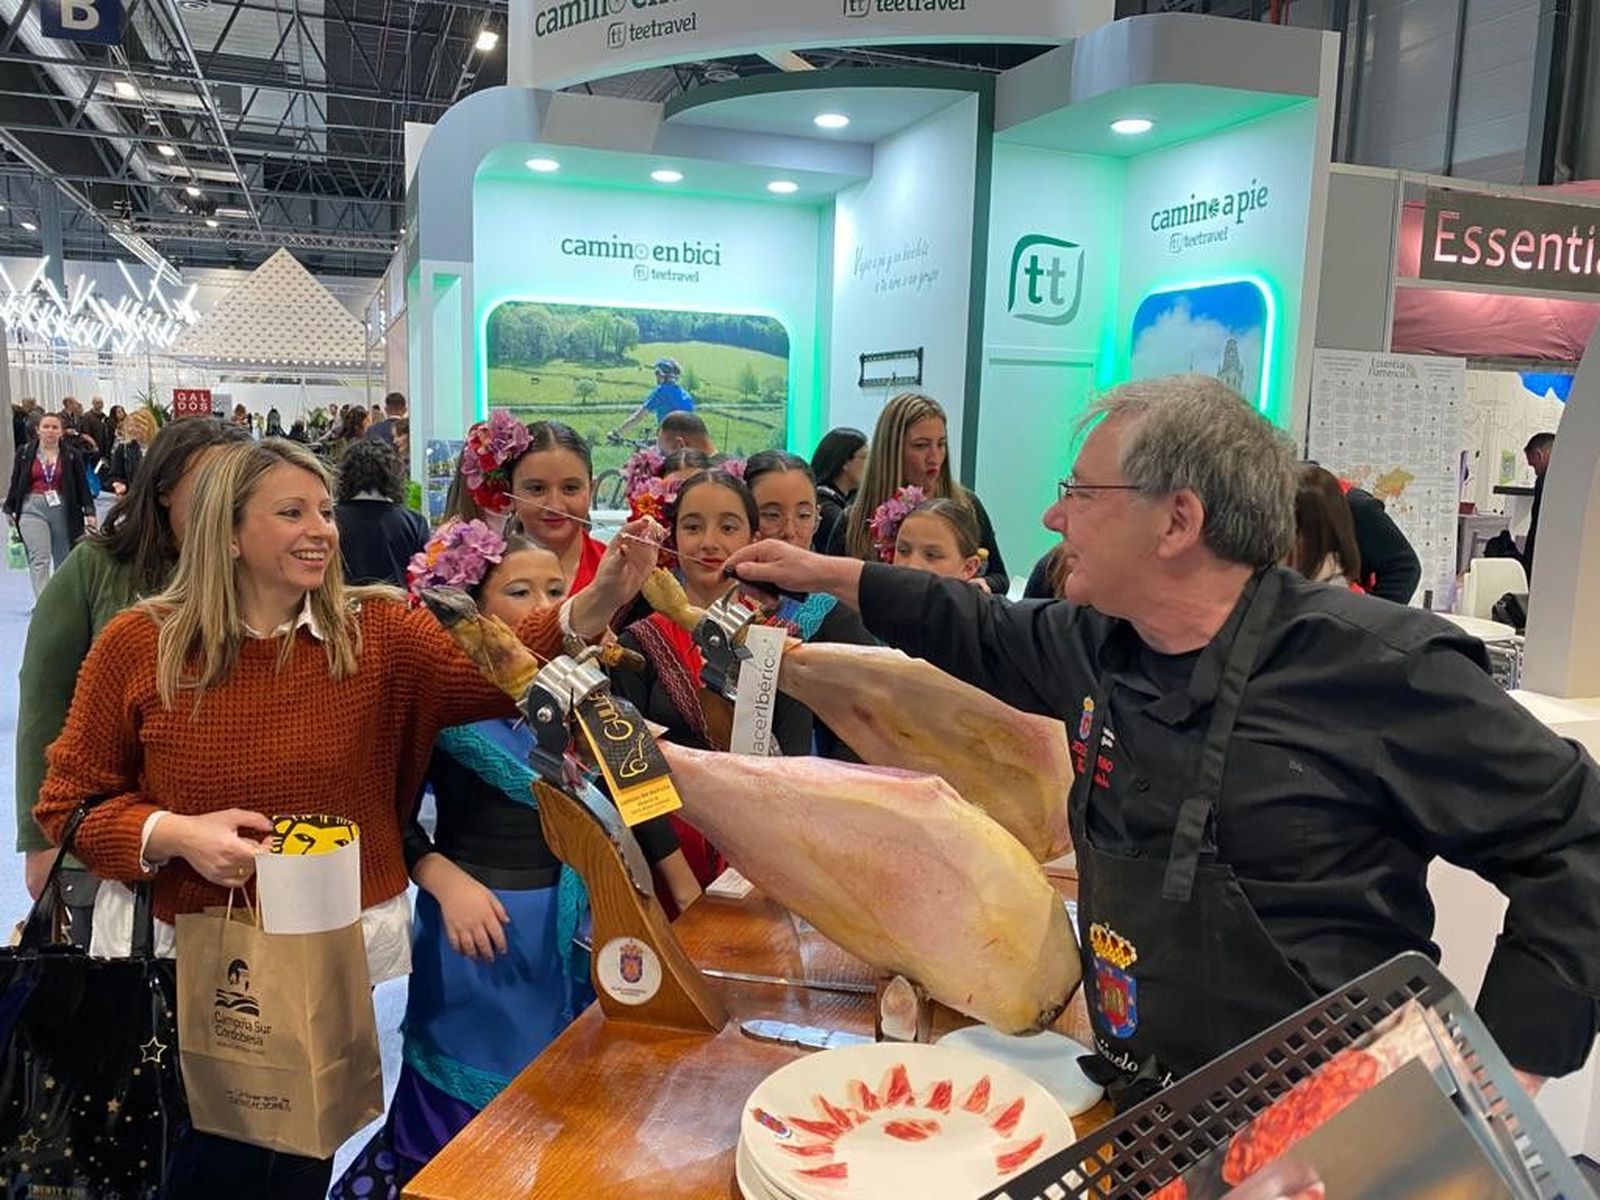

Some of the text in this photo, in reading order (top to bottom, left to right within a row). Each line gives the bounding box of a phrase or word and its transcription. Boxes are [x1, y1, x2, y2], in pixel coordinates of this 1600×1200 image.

[60, 0, 100, 30] B
[629, 12, 697, 42] teetravel
[1184, 226, 1228, 248] teetravel
[1434, 209, 1600, 275] Essenti
[651, 268, 700, 283] teetravel
[177, 392, 208, 402] GAL
[177, 401, 208, 411] DOS
[750, 646, 777, 756] lacerIbérico
